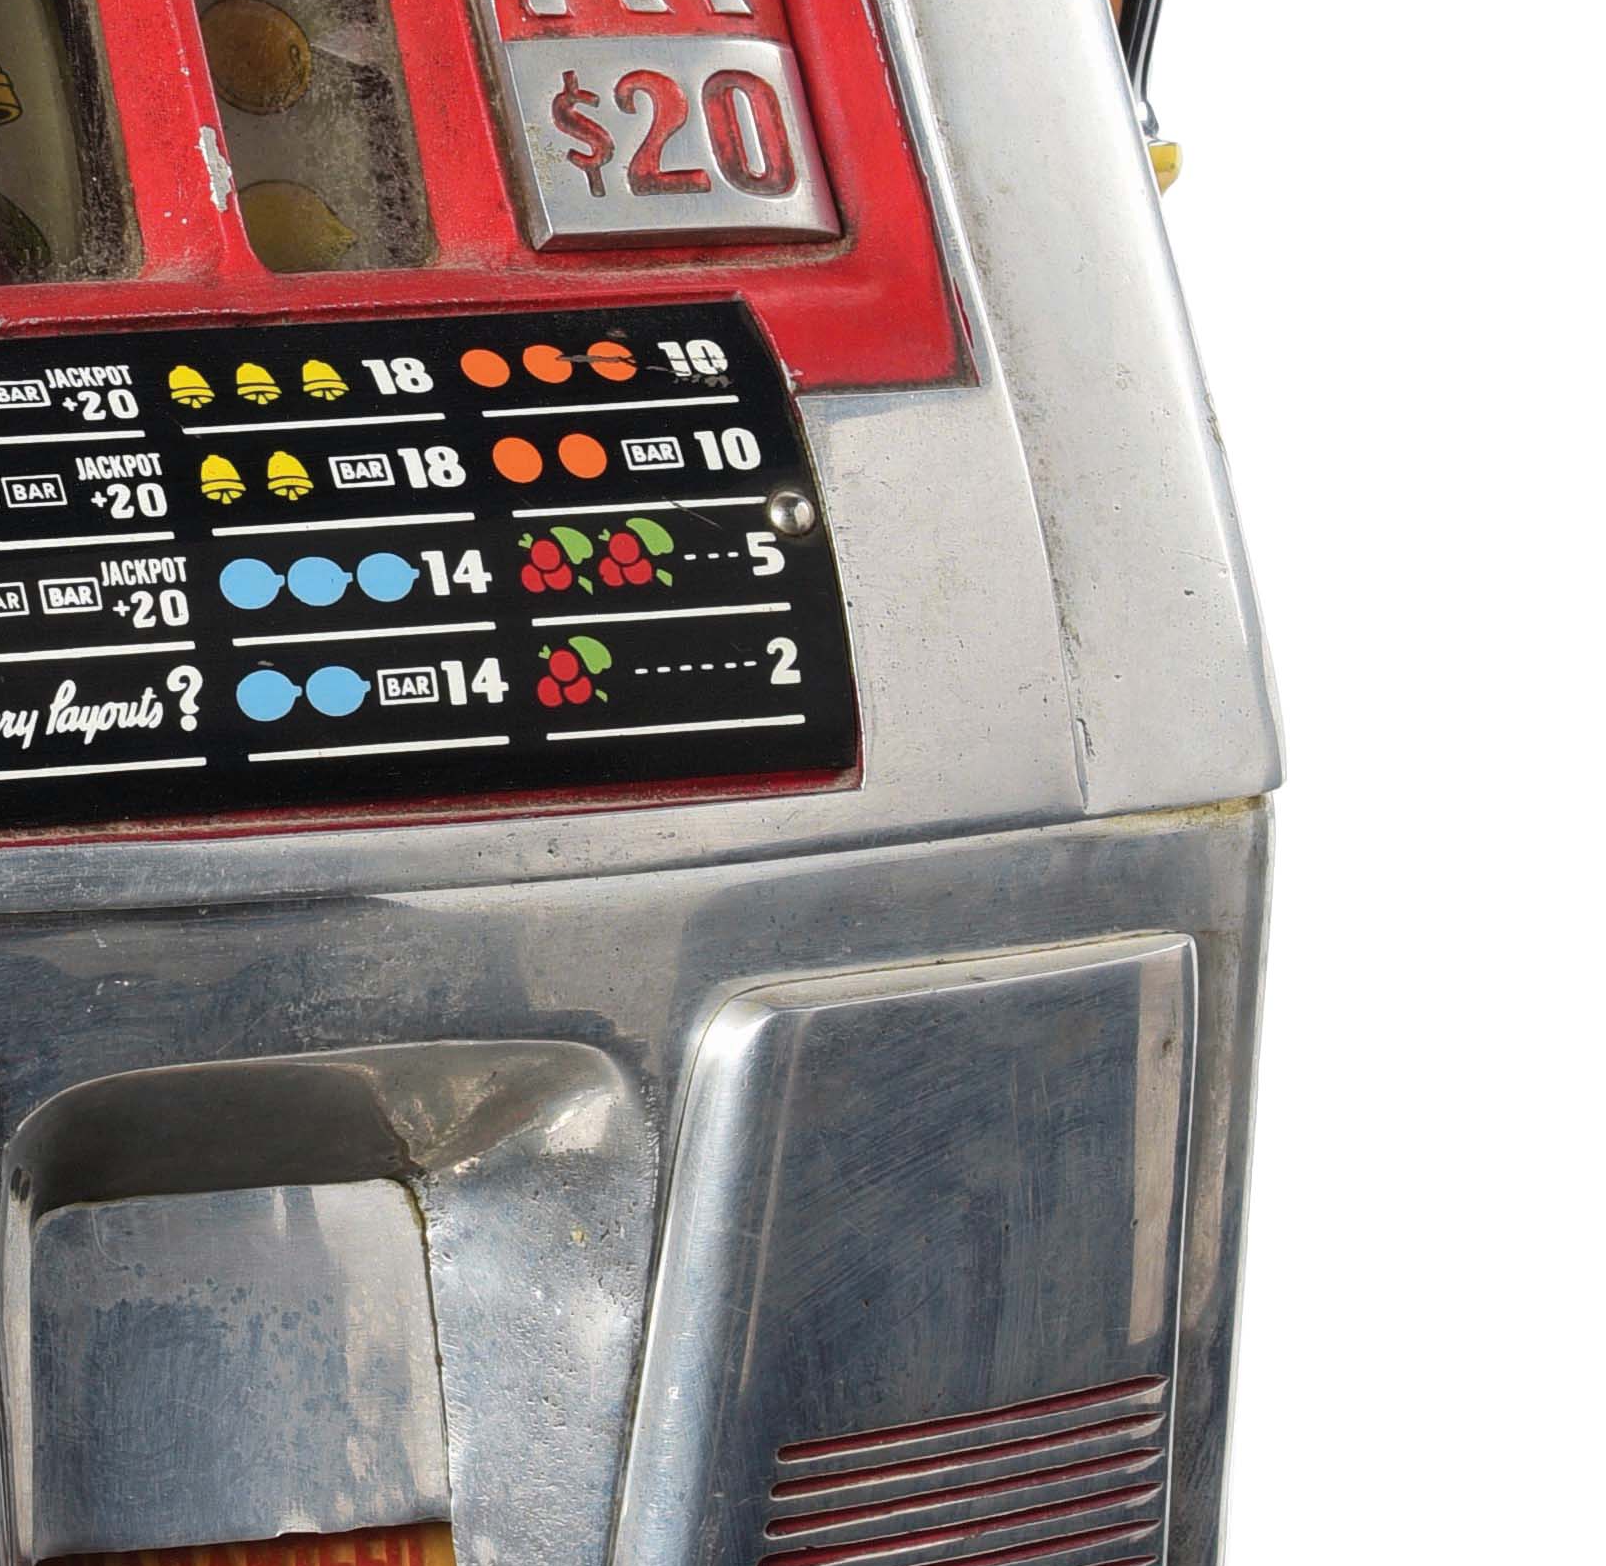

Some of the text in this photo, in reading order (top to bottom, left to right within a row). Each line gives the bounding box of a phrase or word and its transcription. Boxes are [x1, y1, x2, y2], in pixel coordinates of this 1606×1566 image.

[551, 69, 798, 197] $20
[45, 365, 133, 388] JACKPOT
[361, 357, 434, 395] 18
[658, 340, 728, 377] 10
[61, 389, 139, 420] +20
[75, 452, 161, 481] JACKPOT
[339, 446, 467, 489] BAR 18
[631, 427, 761, 470] BAR 10
[10, 481, 58, 502] BAR
[90, 483, 168, 519] +20
[101, 556, 187, 587] JACKPOT
[421, 550, 492, 595] 14
[746, 531, 785, 576] 5
[47, 585, 95, 607] BAR
[112, 589, 190, 629] +20
[767, 637, 801, 685] 2
[385, 657, 509, 705] BAR 14
